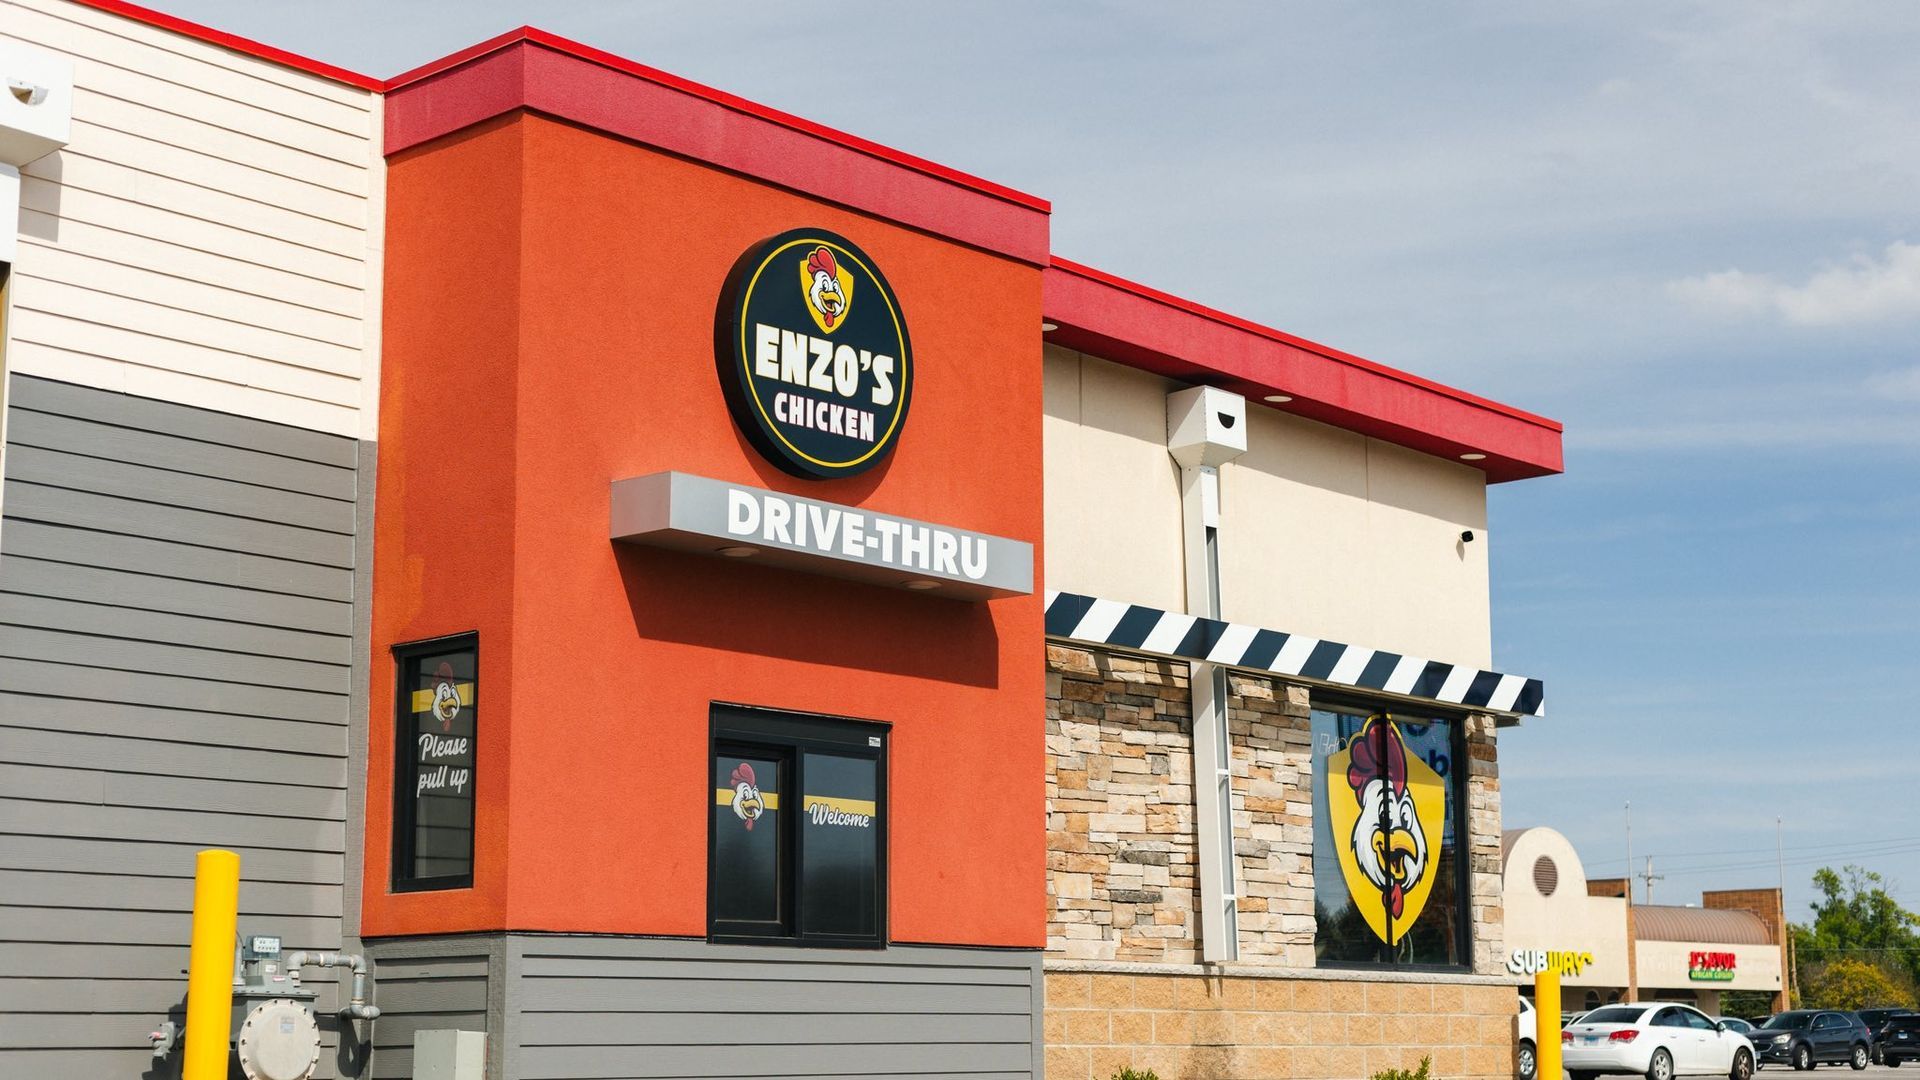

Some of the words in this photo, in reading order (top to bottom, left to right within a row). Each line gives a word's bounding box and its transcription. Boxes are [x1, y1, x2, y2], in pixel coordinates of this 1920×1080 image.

[755, 323, 894, 406] ENZO'S
[774, 392, 875, 442] CHICKEN
[728, 488, 988, 579] DRIVE-THRU
[418, 733, 467, 761] Please
[416, 765, 447, 798] pull
[449, 768, 469, 793] up
[809, 802, 870, 828] Welcome
[1506, 950, 1593, 976] SUBWAY
